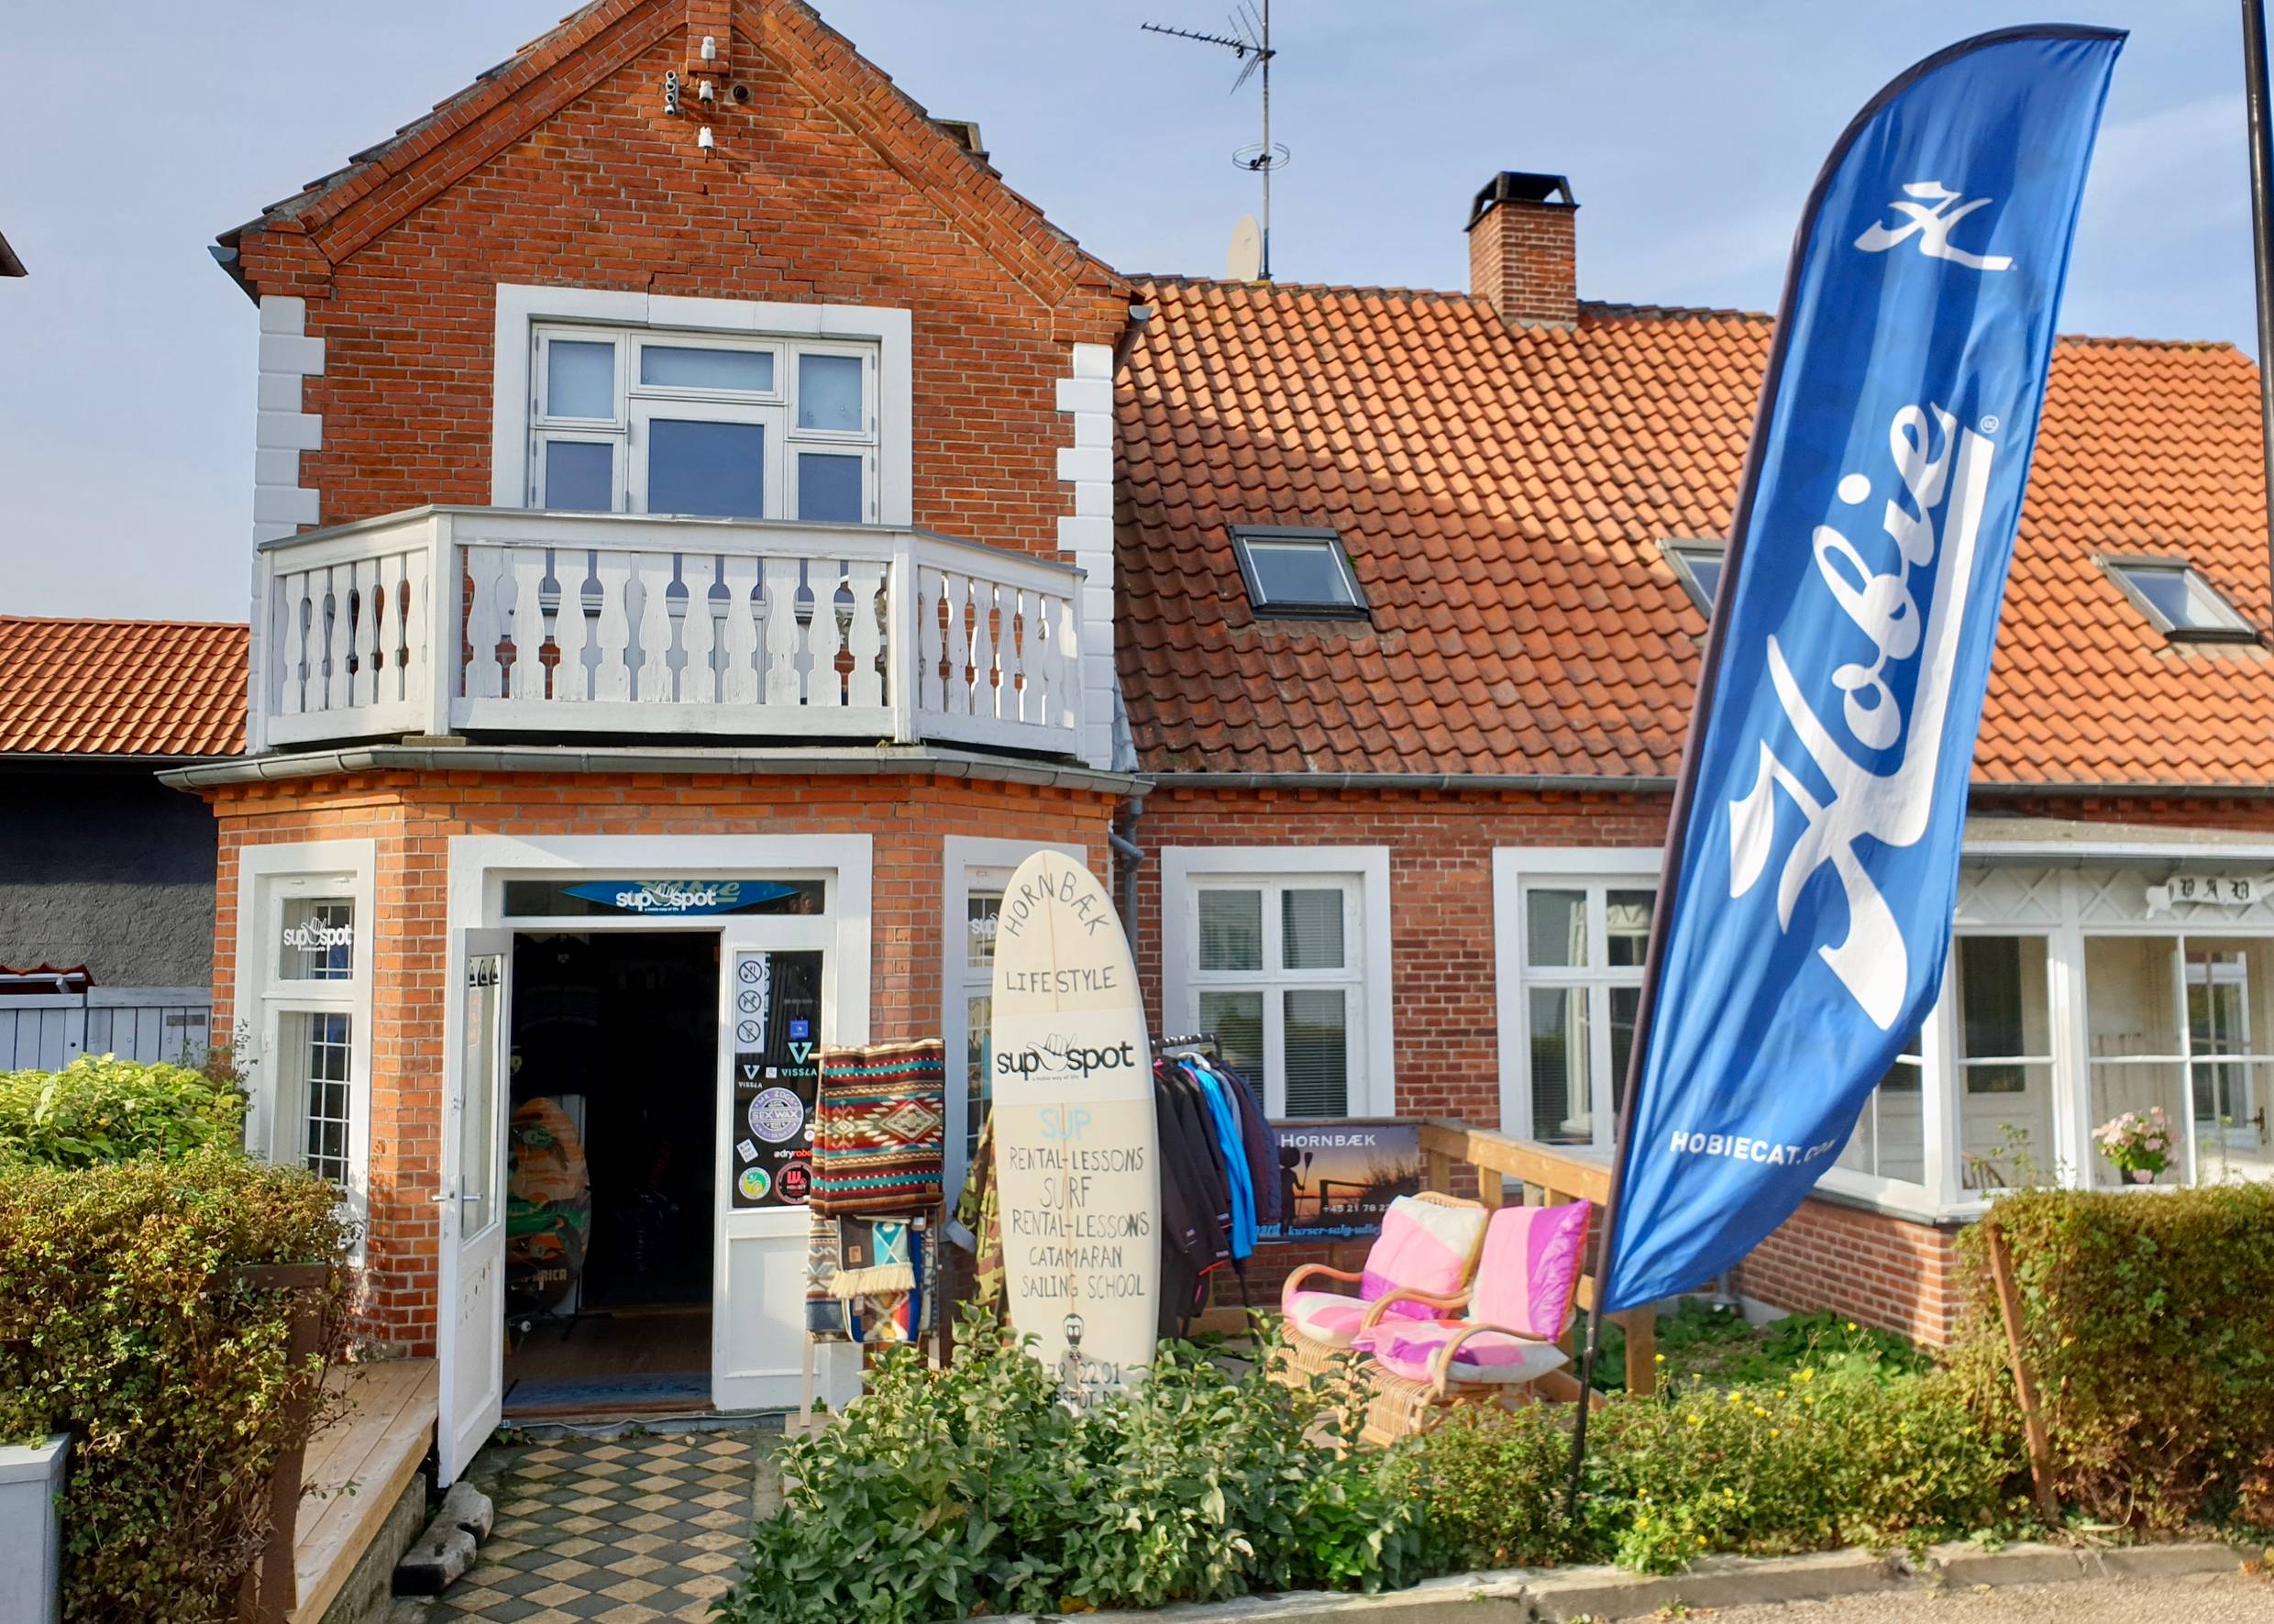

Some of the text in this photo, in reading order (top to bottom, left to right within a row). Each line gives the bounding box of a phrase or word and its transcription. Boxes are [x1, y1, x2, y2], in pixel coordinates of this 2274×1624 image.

[1729, 401, 1994, 1031] Hobie
[615, 889, 717, 911] sup spot
[1005, 871, 1109, 936] HORNBÆK
[283, 923, 353, 951] sup spot
[972, 918, 998, 940] sup
[1006, 966, 1117, 993] LIFESTYLE
[781, 1068, 817, 1077] VISSLA
[997, 1041, 1135, 1081] sup spot
[752, 1110, 798, 1119] SEX WAX
[1040, 1108, 1091, 1142] SUP
[1281, 1133, 1375, 1147] HORNBÆK
[1040, 1177, 1092, 1210] SURF
[1323, 1205, 1344, 1213] +45
[1029, 1245, 1122, 1268] CATAMARAN
[1021, 1274, 1145, 1298] SAILING SCHOOL
